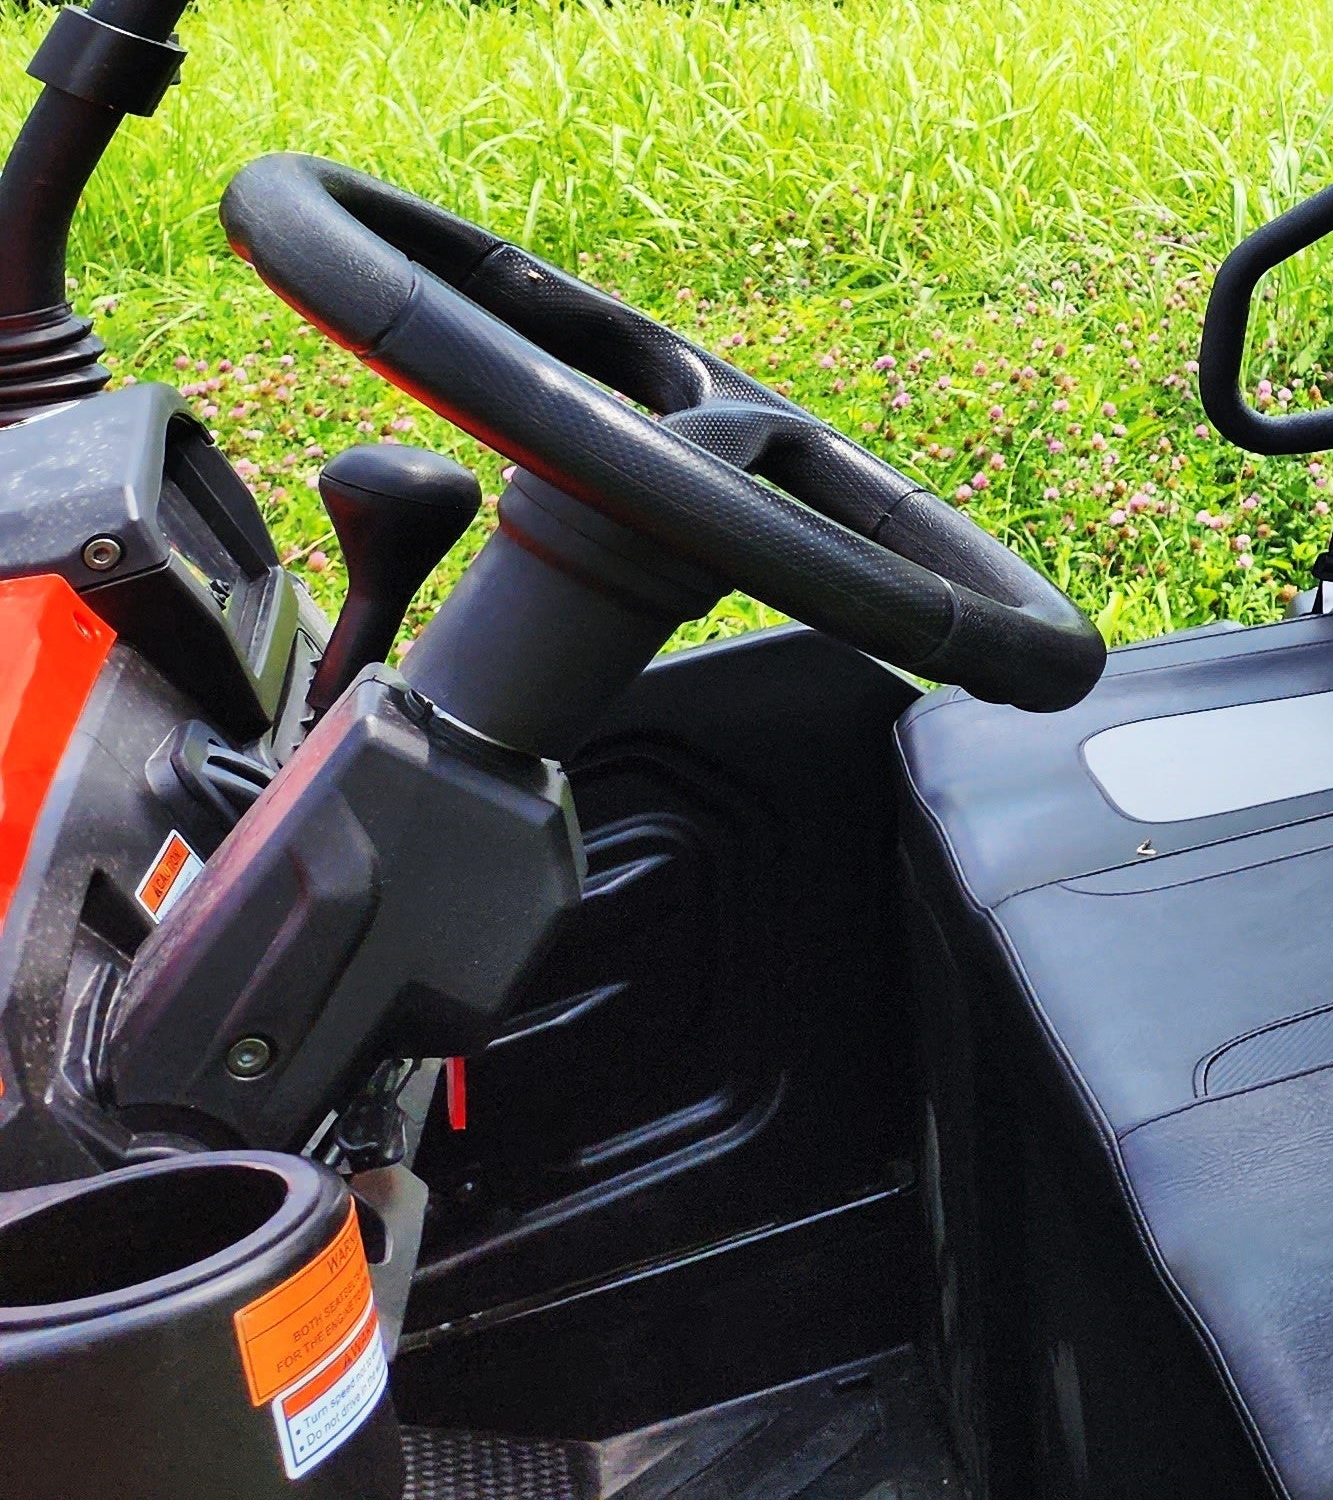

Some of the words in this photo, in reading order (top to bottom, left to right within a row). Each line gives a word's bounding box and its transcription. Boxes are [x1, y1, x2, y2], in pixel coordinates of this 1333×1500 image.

[292, 1312, 323, 1344] BOTH
[276, 1349, 303, 1375] FOR
[303, 1333, 325, 1357] THE
[303, 1402, 330, 1429] Turn
[330, 1378, 356, 1409] speed
[306, 1426, 324, 1447] Do
[324, 1411, 341, 1433] not
